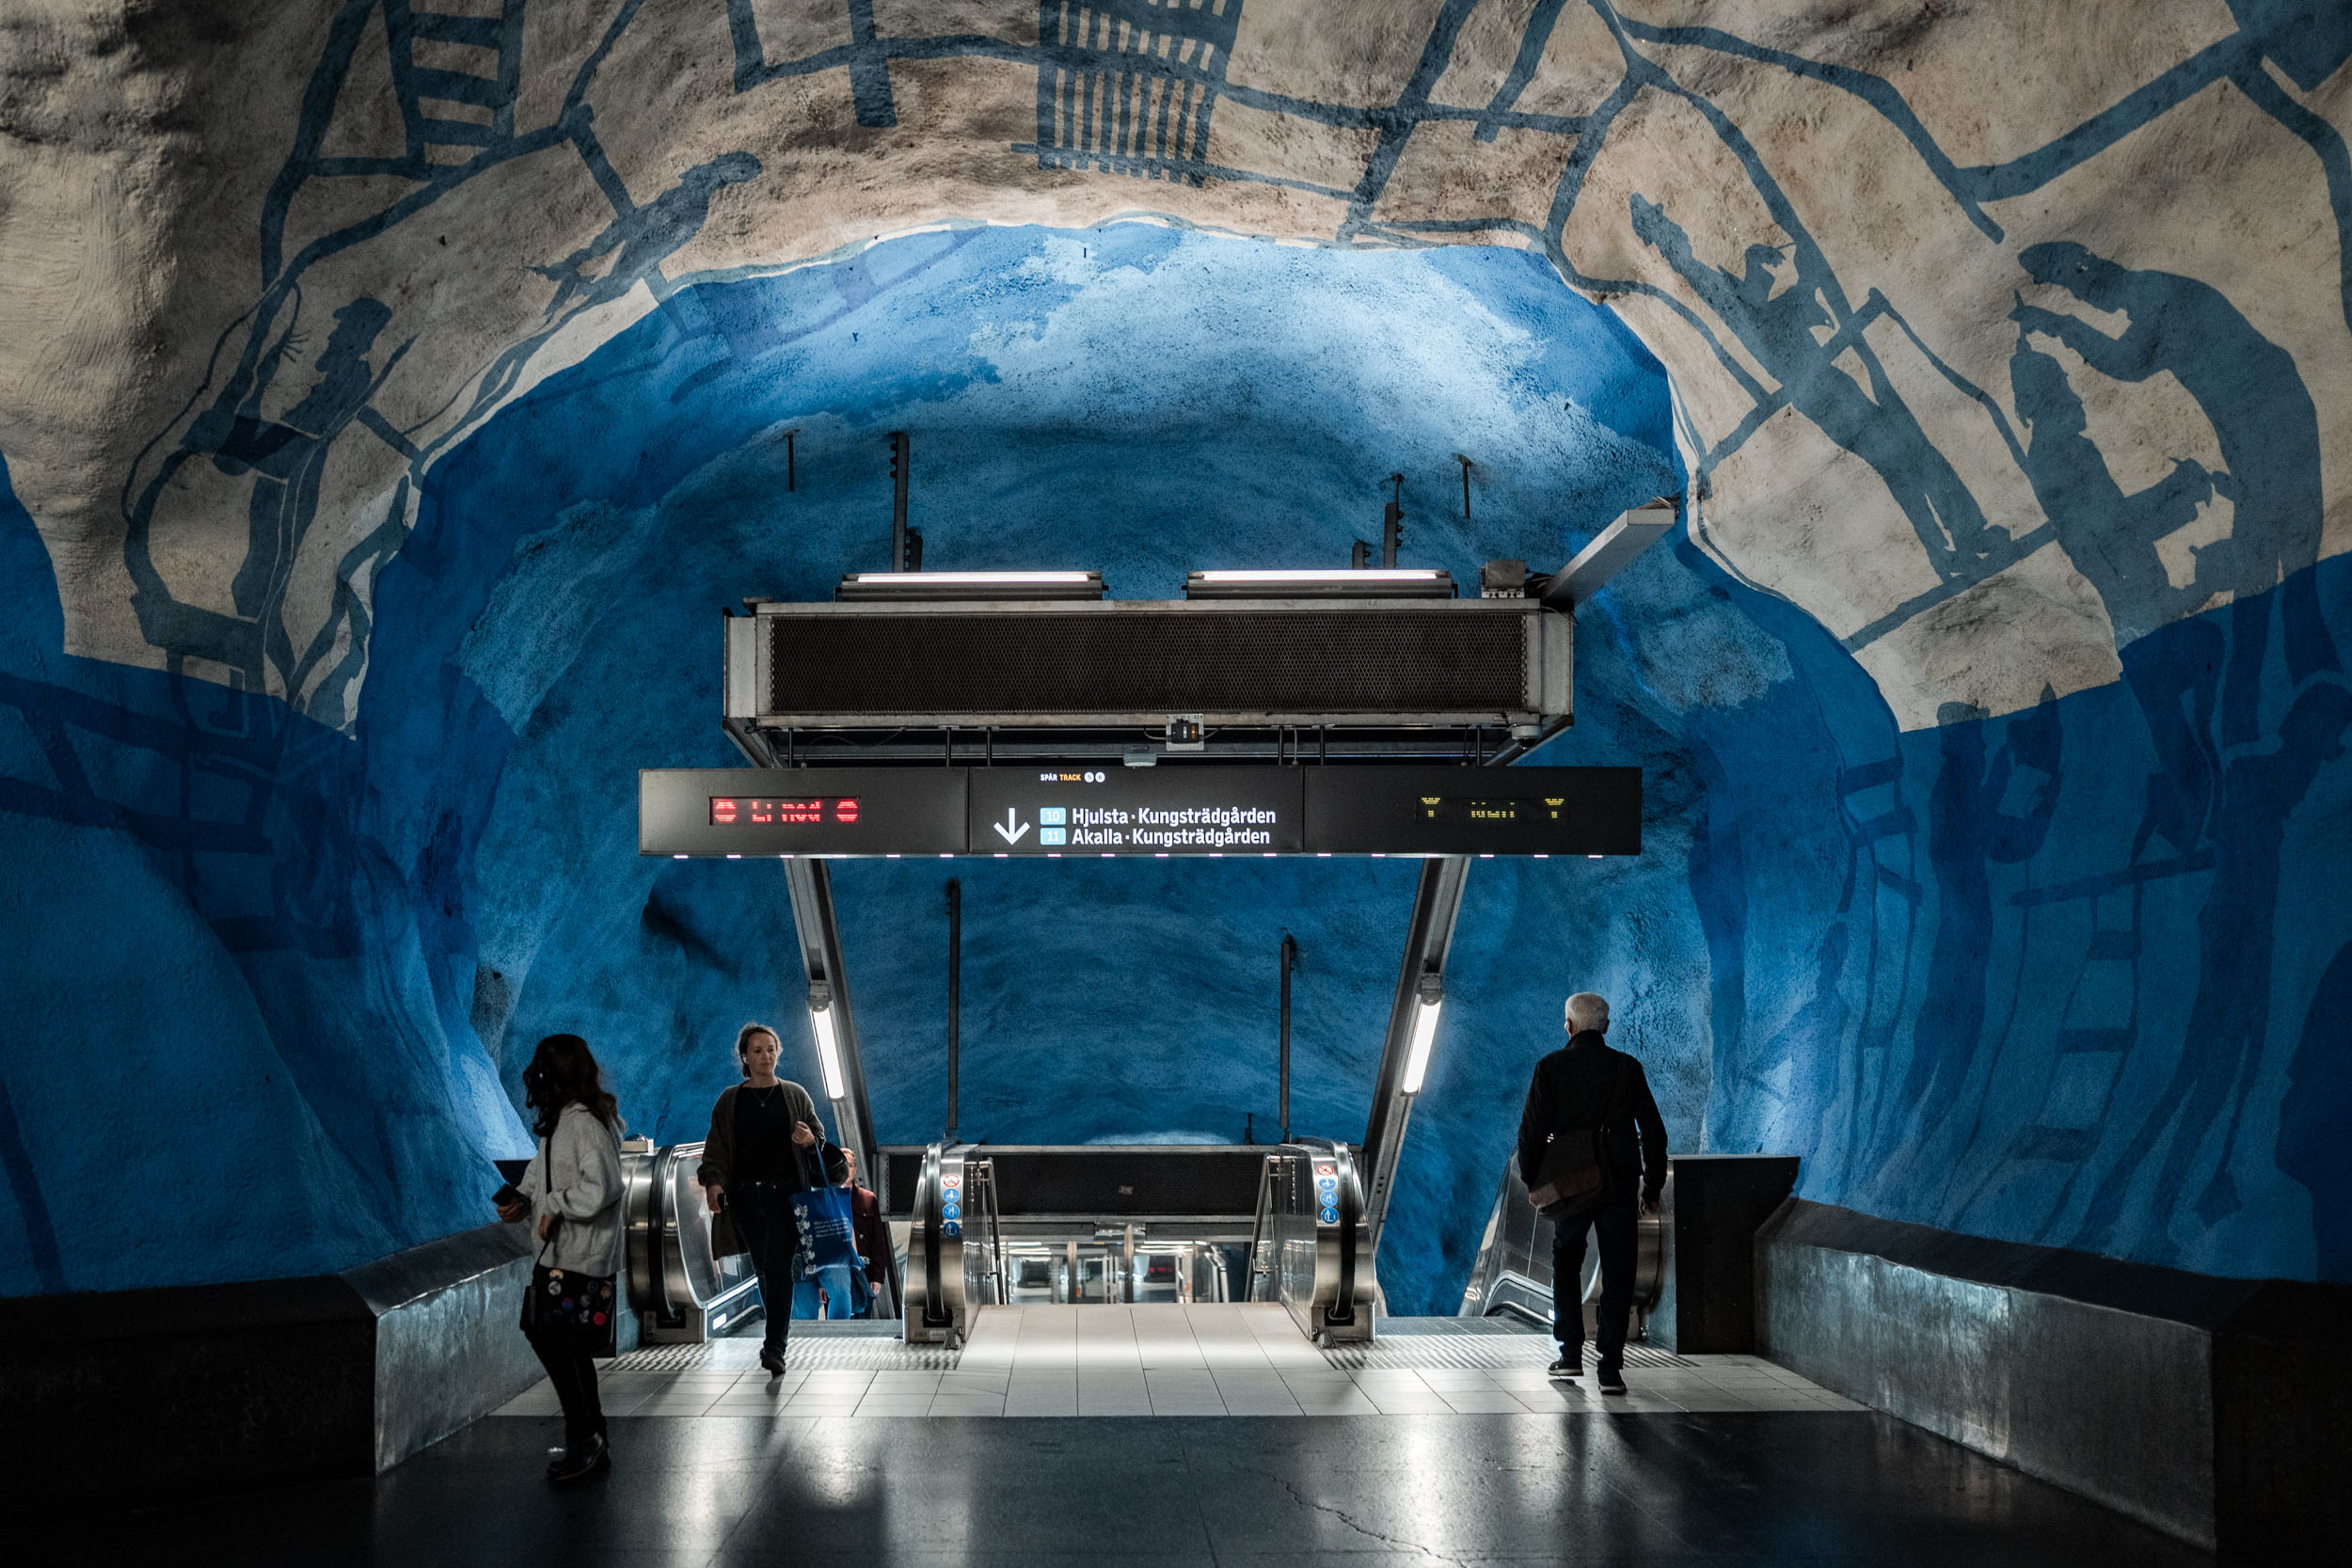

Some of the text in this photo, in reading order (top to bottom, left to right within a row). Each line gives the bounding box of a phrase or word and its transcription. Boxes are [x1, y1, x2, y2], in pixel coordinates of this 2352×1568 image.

[1040, 772, 1057, 782] SPÅR
[1059, 773, 1081, 782] TRACK
[1046, 806, 1277, 828] 10 Hjulsta Kungsträdgården
[1047, 828, 1270, 847] 11 Akalla Kungsträdgården
